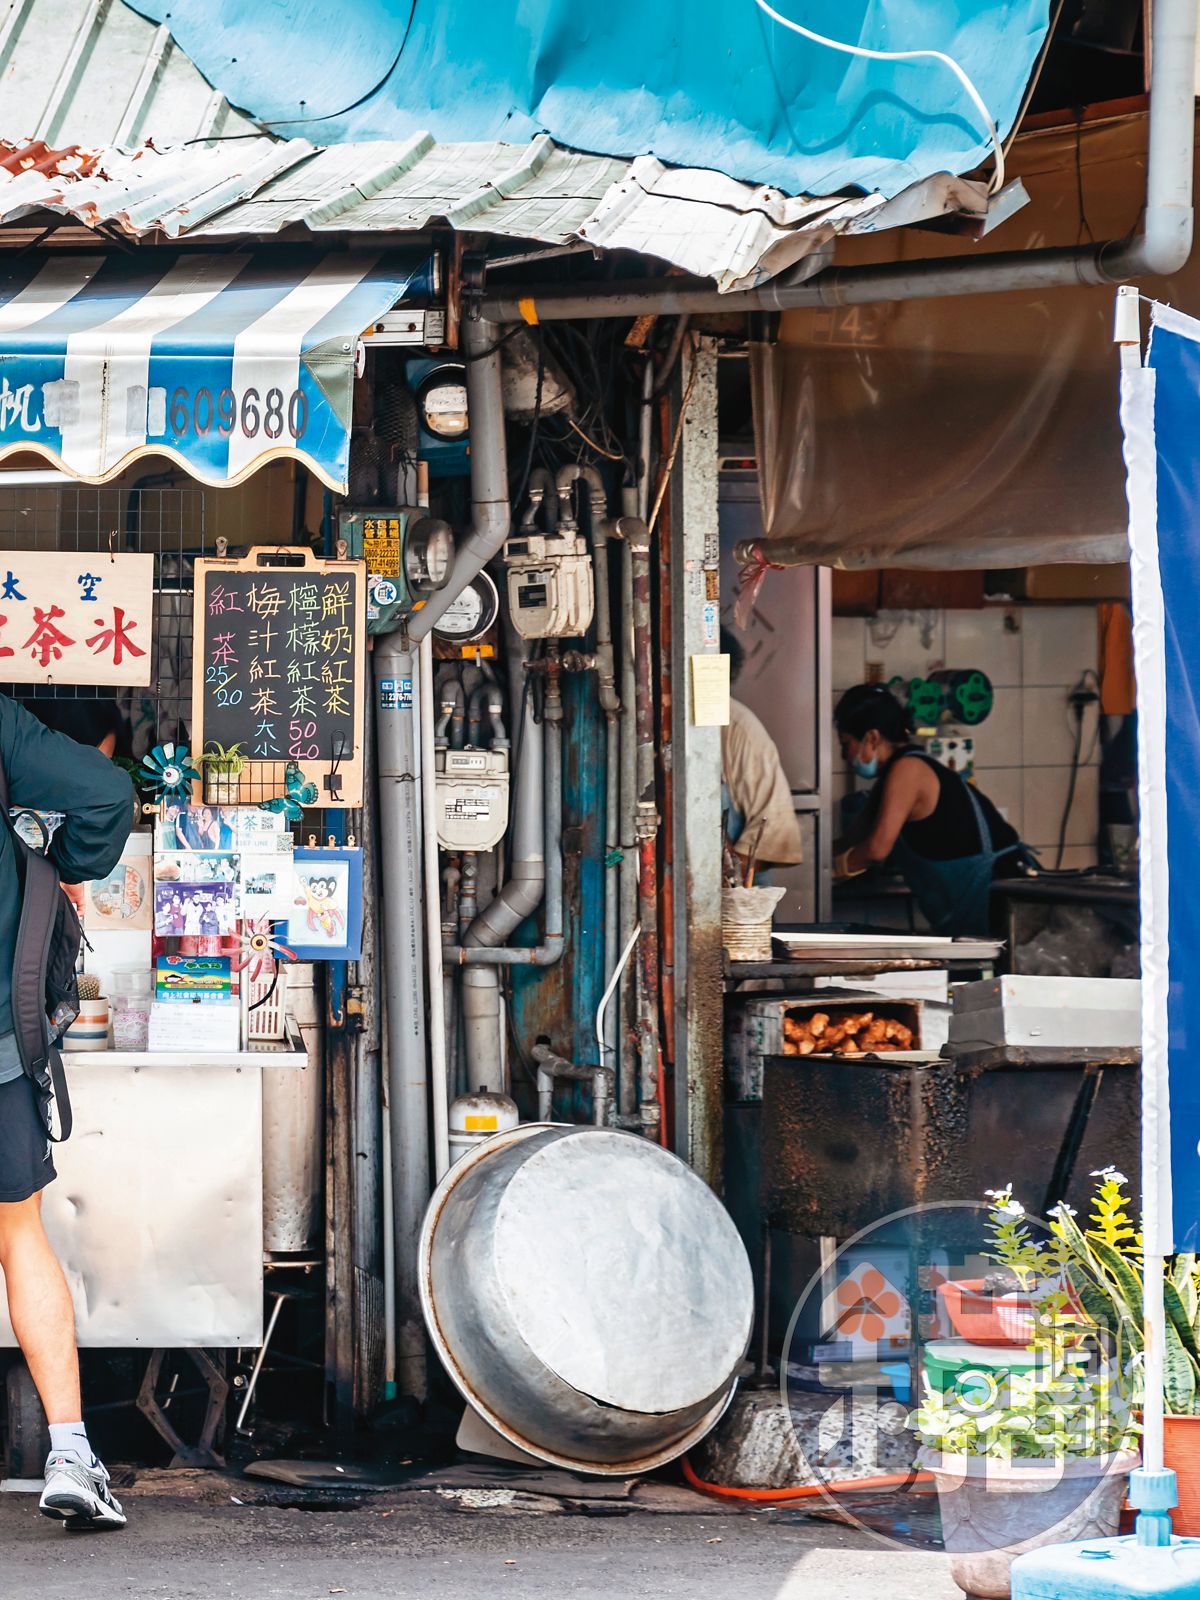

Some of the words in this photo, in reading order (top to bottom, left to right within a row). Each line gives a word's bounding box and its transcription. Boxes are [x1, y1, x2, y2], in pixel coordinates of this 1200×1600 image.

[0, 571, 103, 601] 太空
[366, 559, 400, 568] 977-414999
[208, 584, 245, 666] 紅茶
[246, 582, 287, 717] 梅汁紅茶
[285, 581, 321, 718] 檸檬紅茶
[320, 581, 354, 716] 鮮奶紅茶
[254, 718, 277, 740] 大
[289, 719, 317, 741] 50
[254, 740, 281, 757] 小
[289, 740, 320, 760] 40
